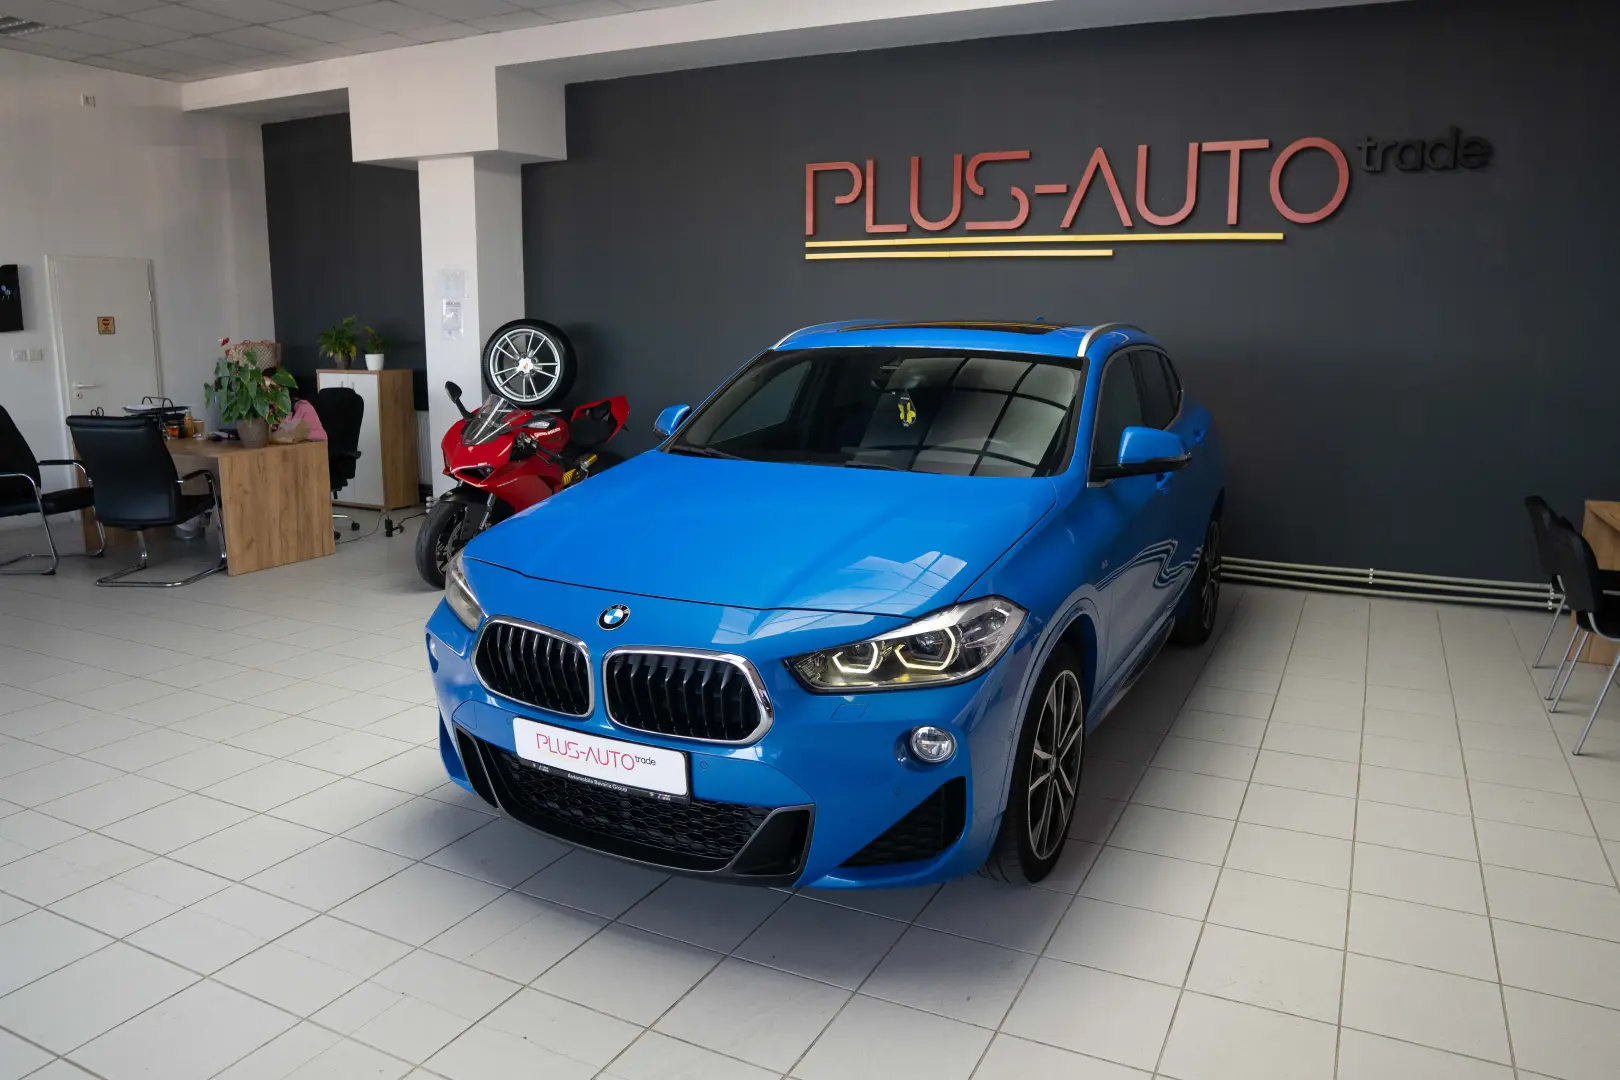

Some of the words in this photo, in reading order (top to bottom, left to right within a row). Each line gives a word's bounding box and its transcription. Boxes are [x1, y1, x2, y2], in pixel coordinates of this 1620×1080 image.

[806, 137, 1349, 235] PLUS-AUTO
[1356, 125, 1492, 173] trade
[536, 733, 634, 770] PLUS-AUTO
[635, 755, 656, 766] trade
